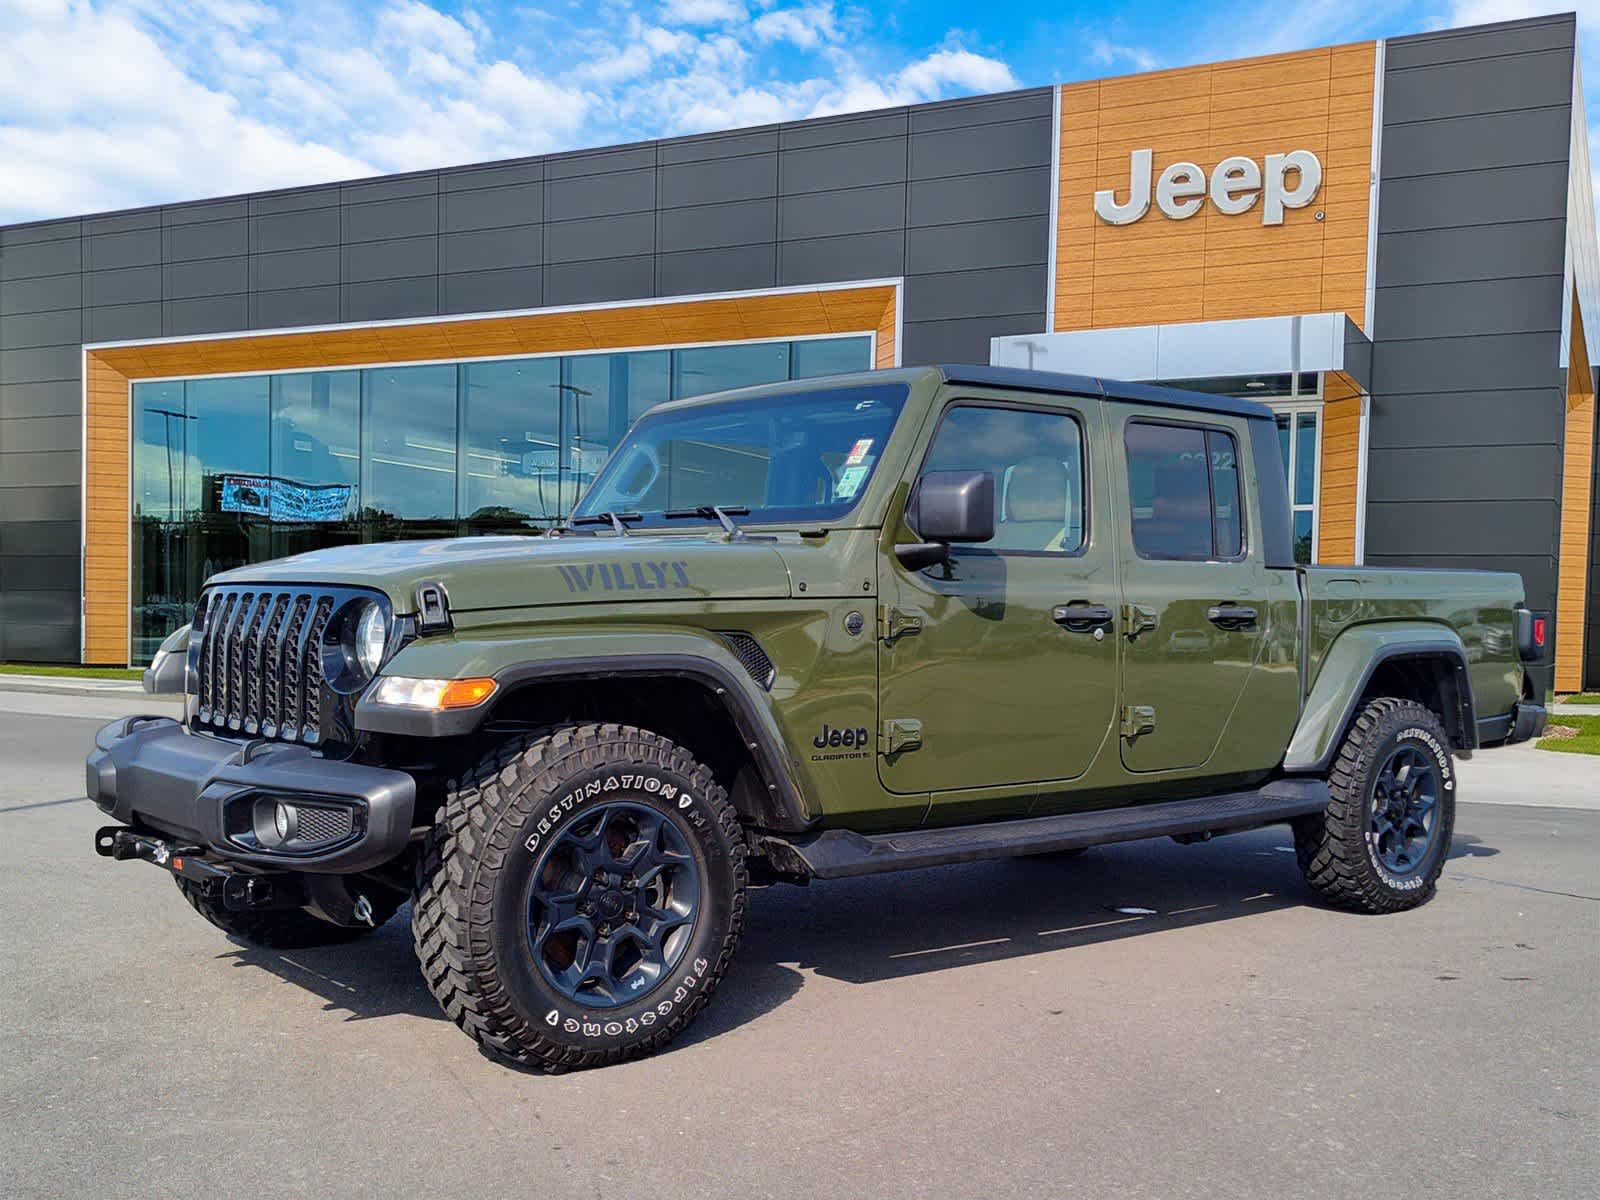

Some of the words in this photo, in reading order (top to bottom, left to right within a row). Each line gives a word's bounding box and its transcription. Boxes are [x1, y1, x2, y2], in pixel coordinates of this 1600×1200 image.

[1094, 148, 1322, 226] Jeep
[557, 561, 689, 593] WILLYS
[813, 723, 868, 750] Jeep
[524, 775, 678, 852] DESTINATION
